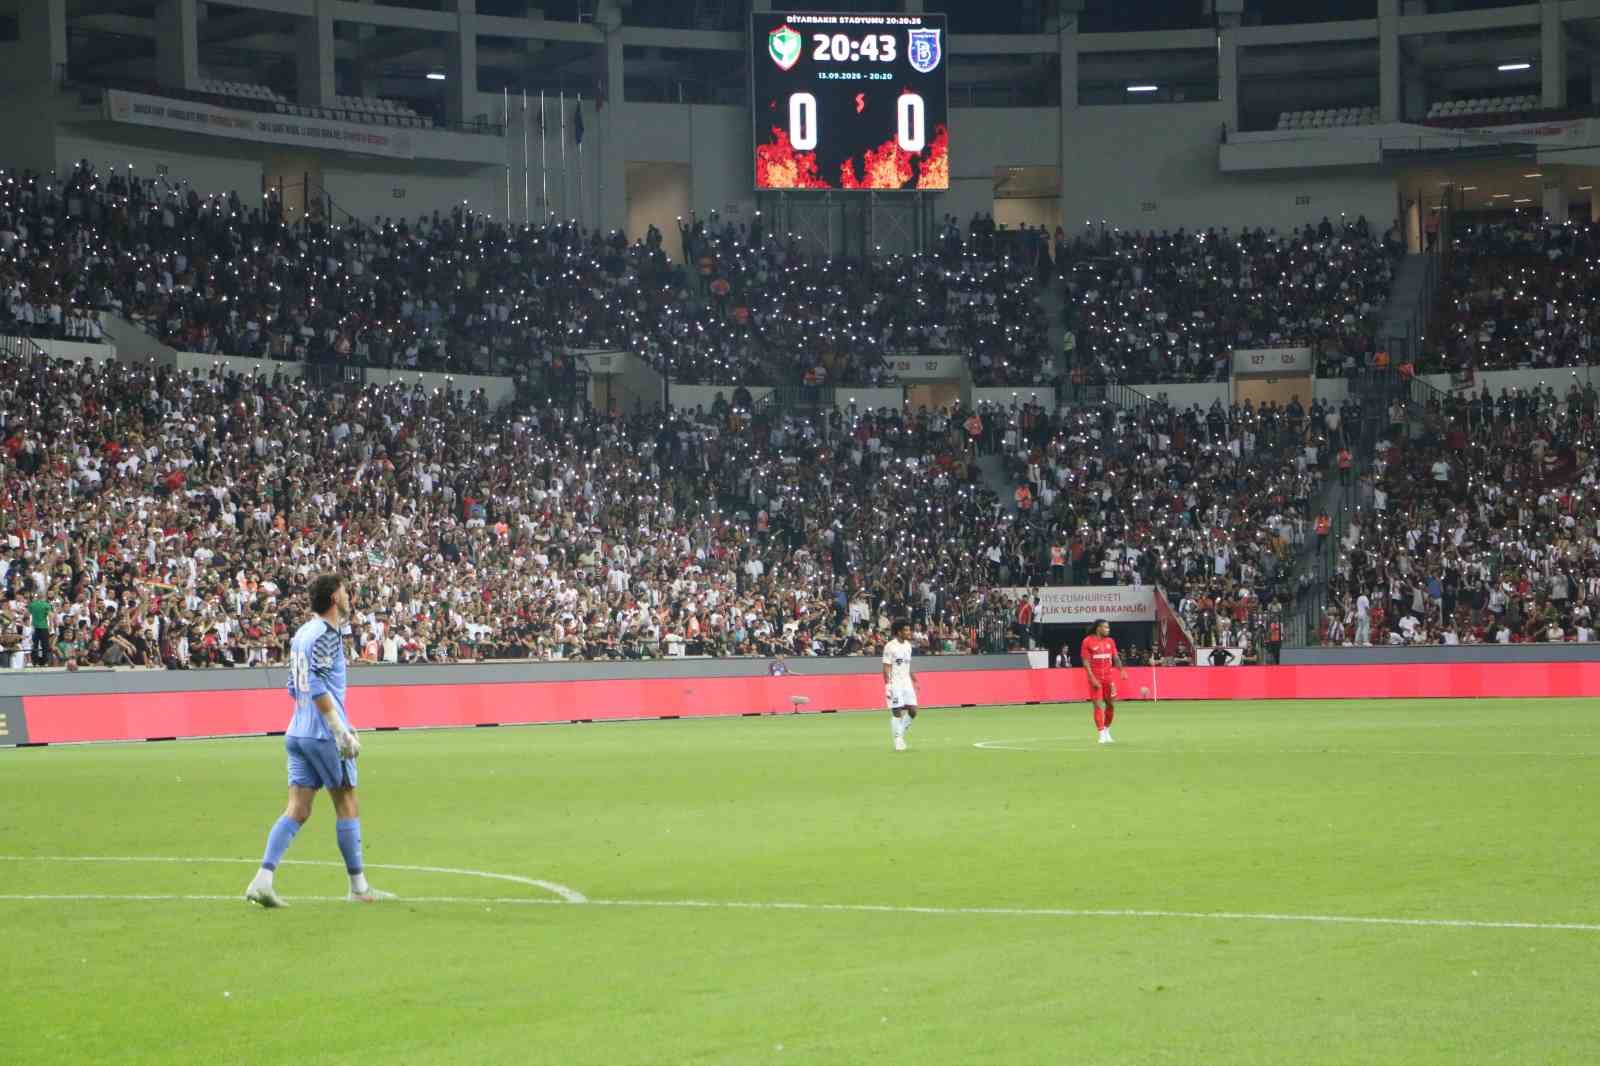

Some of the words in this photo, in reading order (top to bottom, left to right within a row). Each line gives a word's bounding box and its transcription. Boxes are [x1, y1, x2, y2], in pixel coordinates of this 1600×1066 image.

[787, 14, 837, 23] DİYARBAKIR
[839, 16, 884, 24] STADYUMU
[812, 34, 897, 61] 20:43
[789, 93, 817, 150] 0
[898, 93, 925, 152] 0
[1073, 605, 1097, 614] SPOR
